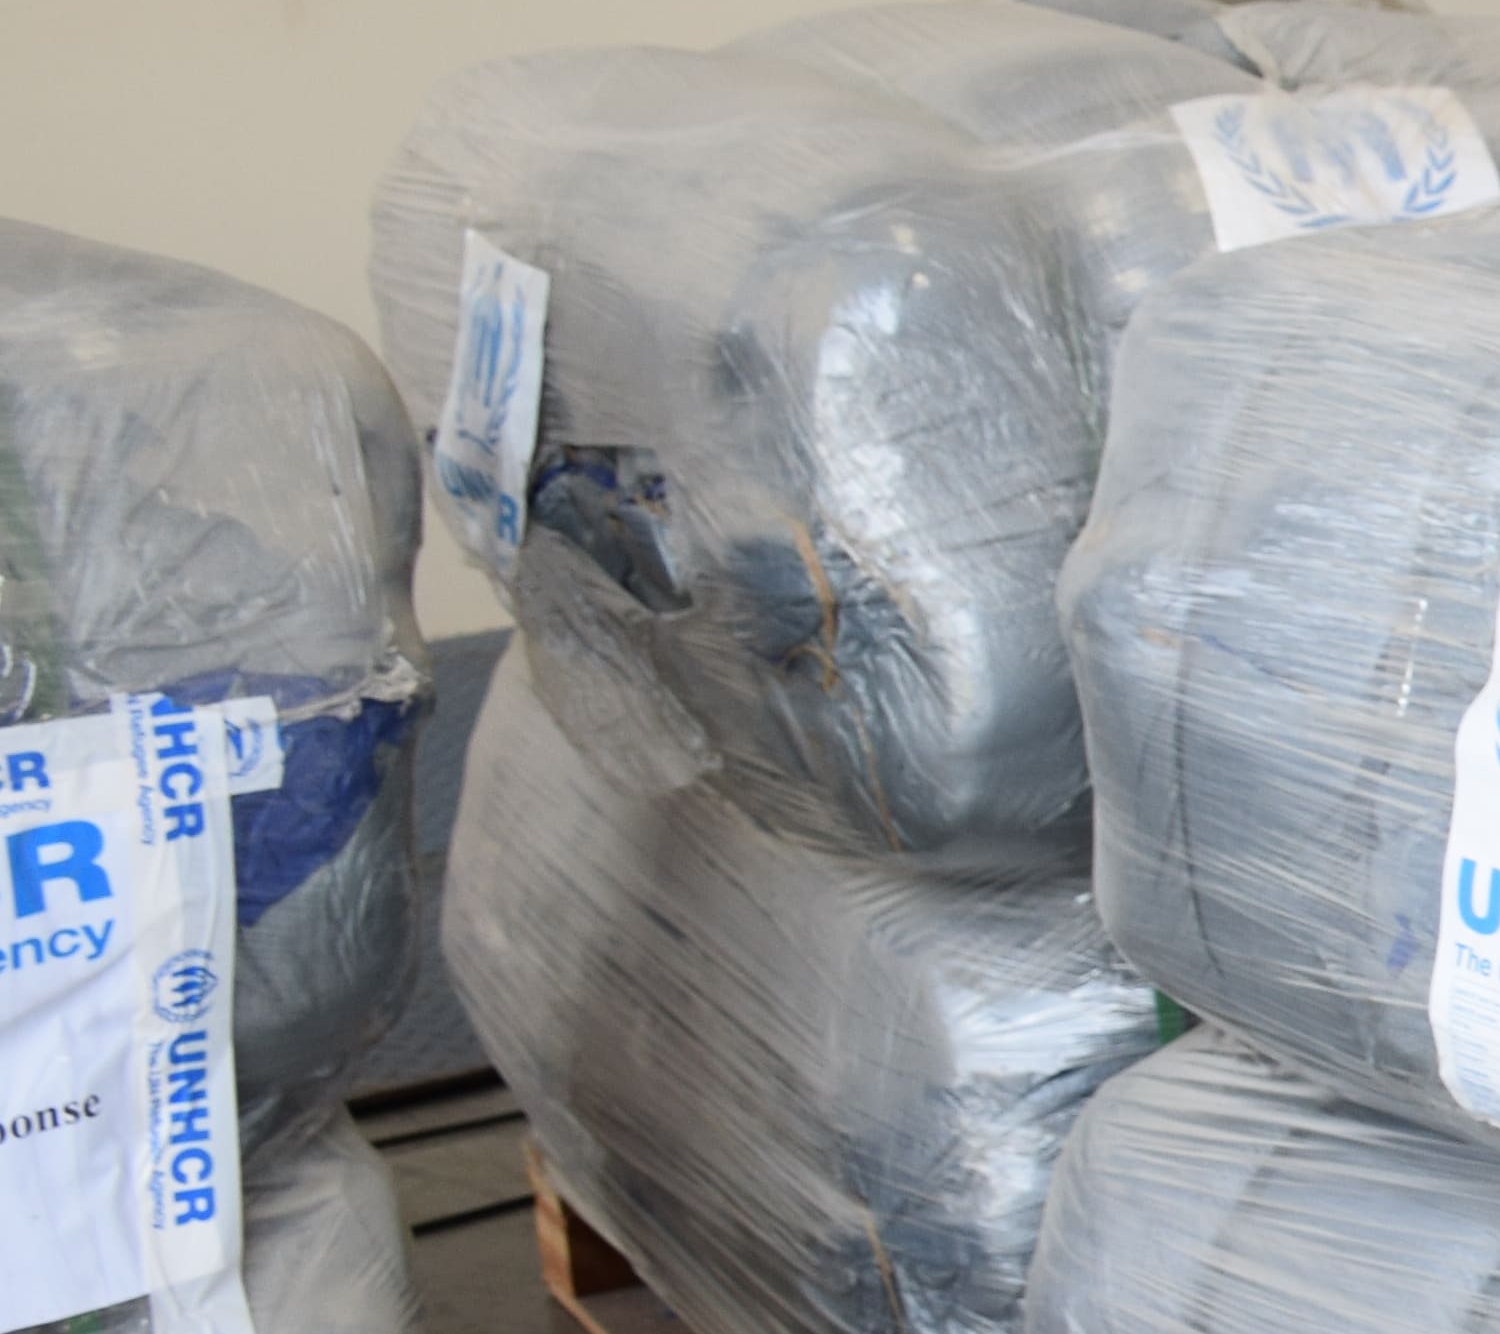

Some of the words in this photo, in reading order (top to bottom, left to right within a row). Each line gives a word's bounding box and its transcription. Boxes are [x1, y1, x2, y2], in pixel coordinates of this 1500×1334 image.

[0, 918, 115, 970] ncy
[1454, 941, 1491, 978] The
[168, 1030, 217, 1229] UNHCR
